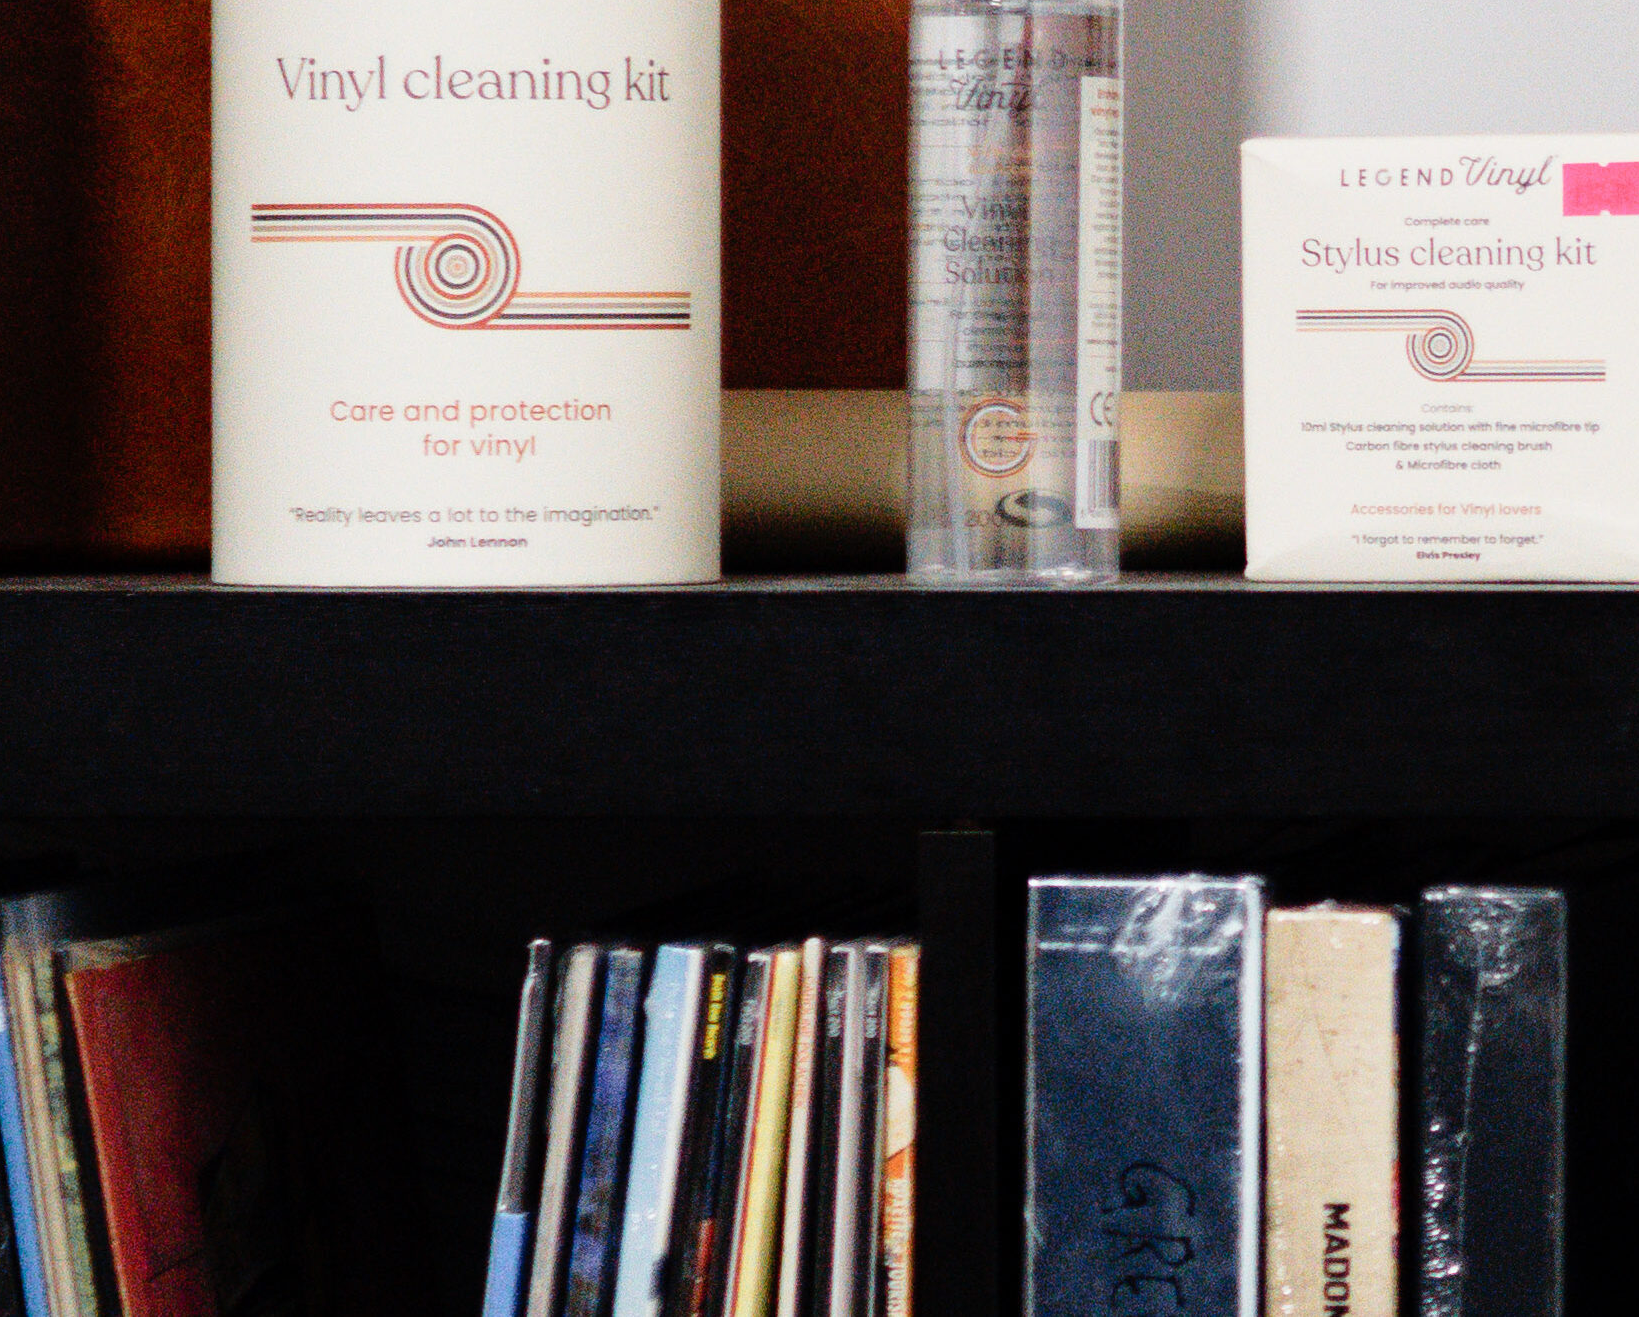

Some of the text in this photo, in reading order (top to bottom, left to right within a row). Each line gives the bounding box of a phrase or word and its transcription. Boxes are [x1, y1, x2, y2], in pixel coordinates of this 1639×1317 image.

[938, 48, 1069, 70] LEGEND
[276, 55, 671, 112] Vinyl cleaning kit
[1340, 155, 1556, 195] LEGEND Vinyl
[1405, 217, 1490, 229] Complete care
[1301, 237, 1598, 274] Stylus cleaning kit
[1370, 279, 1525, 292] For improved audio quality
[329, 399, 612, 429] Care and protection
[1329, 422, 1364, 435] Stylus
[1366, 422, 1416, 435] cleaning
[1419, 422, 1464, 433] solution
[1467, 422, 1493, 433] with
[1496, 422, 1516, 433] fine
[1520, 422, 1581, 433] microfibre
[1584, 422, 1600, 435] tip
[424, 434, 537, 464] for vinyl
[1345, 440, 1552, 454] Carbon fibre stylus cleaning brush
[1396, 459, 1501, 470] & Microfibre cloth
[358, 507, 537, 524] leaves a lot to the
[1350, 503, 1542, 516] Accessories for lovers
[427, 536, 528, 548] John Lennon
[1363, 534, 1496, 547] forgot to remember to
[1416, 551, 1480, 561] Elvis Presley
